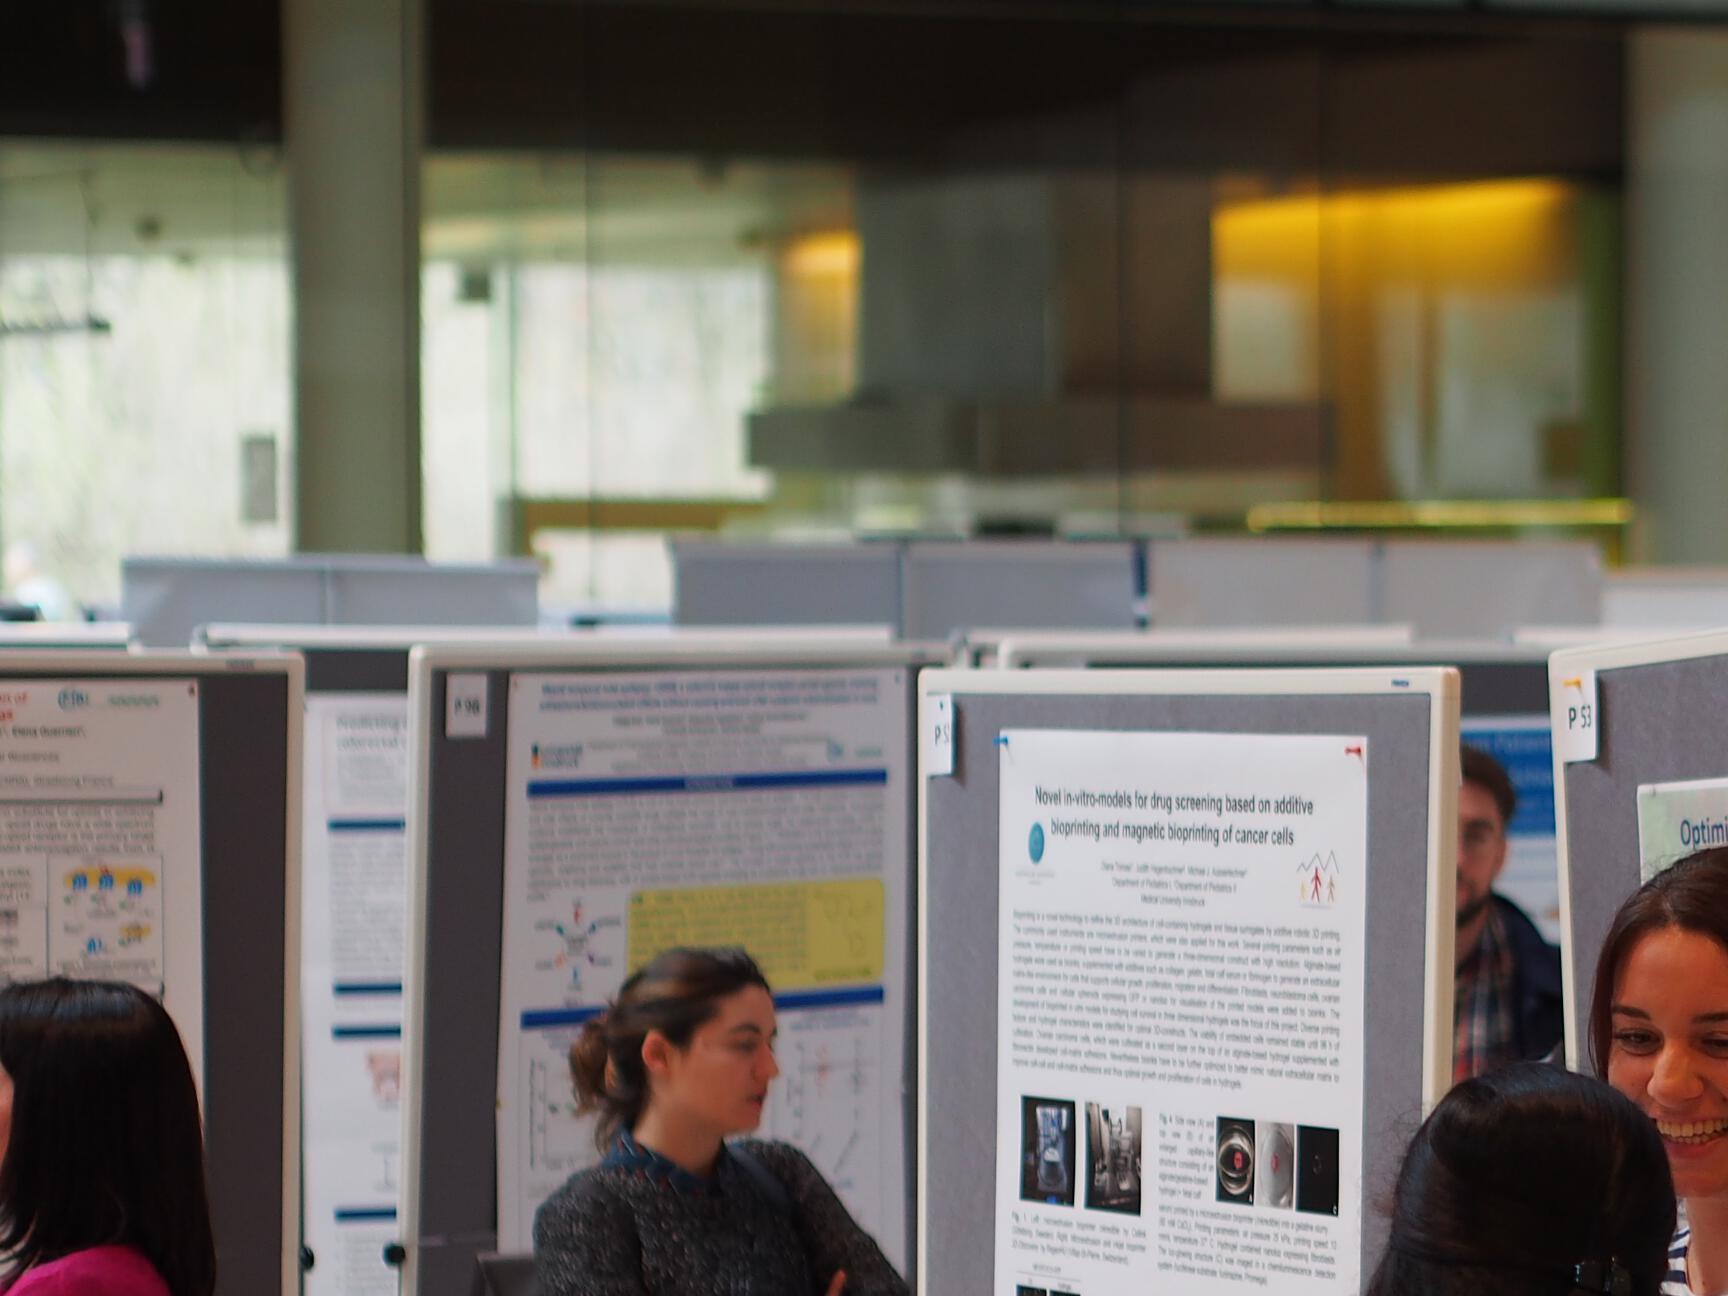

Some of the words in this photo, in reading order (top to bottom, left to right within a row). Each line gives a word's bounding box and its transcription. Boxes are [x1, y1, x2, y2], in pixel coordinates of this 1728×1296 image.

[1568, 706, 1577, 730] P
[1581, 705, 1592, 729] 53
[934, 725, 941, 745] P
[1034, 786, 1062, 807] Novel
[1064, 788, 1132, 809] in-vitro-models
[1135, 790, 1148, 809] for
[1151, 791, 1172, 816] drug
[1175, 793, 1222, 818] screening
[1226, 795, 1255, 814] based
[1258, 799, 1271, 814] on
[1274, 794, 1314, 815] additive
[1050, 817, 1101, 842] bioprinting
[1103, 821, 1120, 838] and
[1122, 822, 1165, 844] magnetic
[1168, 823, 1220, 847] bioprinting
[1222, 825, 1233, 841] of
[1235, 829, 1269, 845] cancer
[1271, 827, 1294, 846] cells
